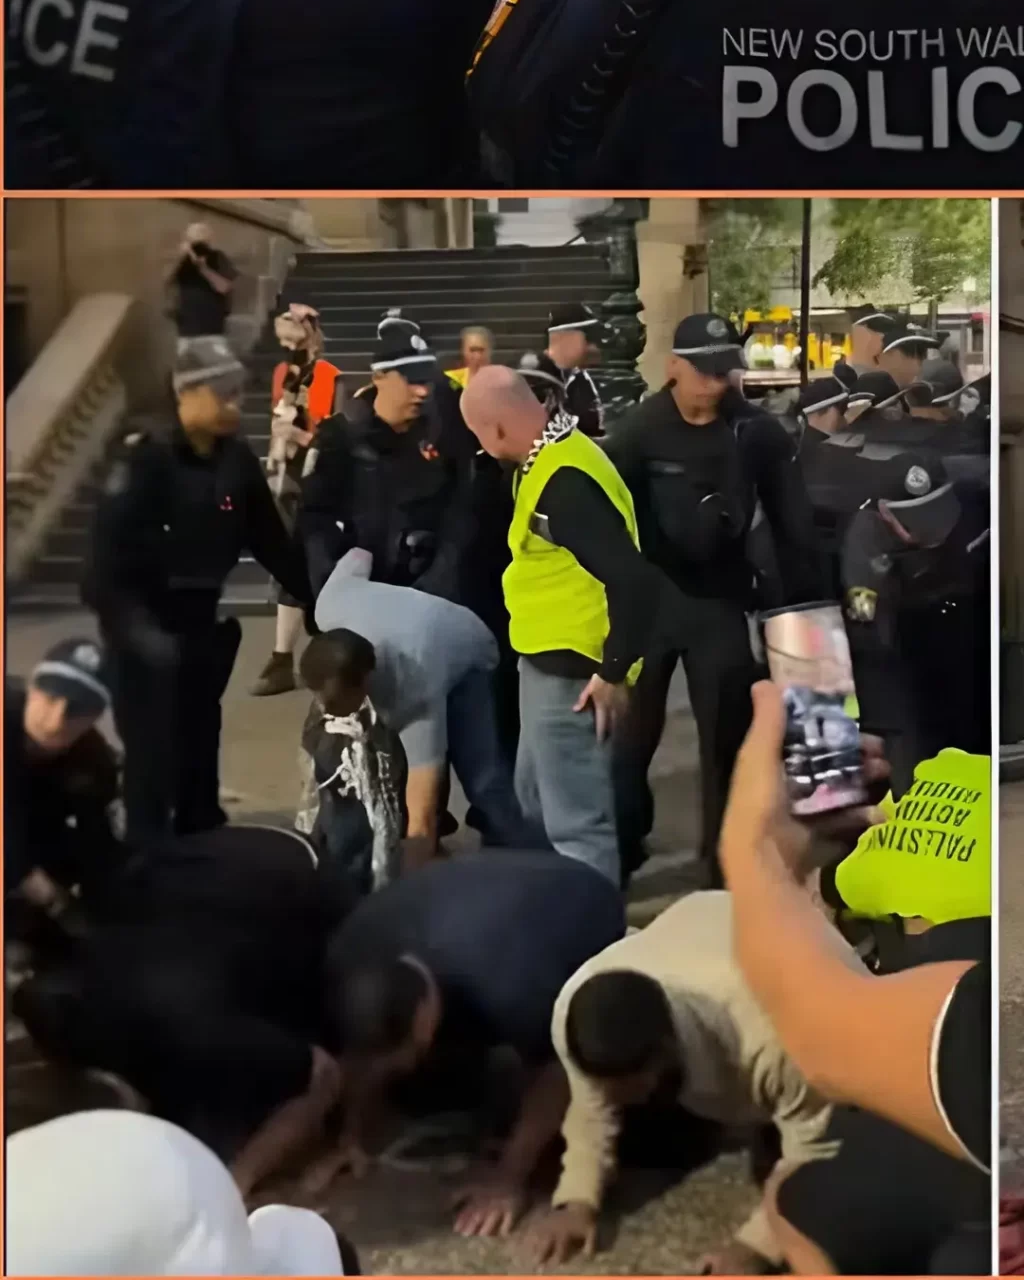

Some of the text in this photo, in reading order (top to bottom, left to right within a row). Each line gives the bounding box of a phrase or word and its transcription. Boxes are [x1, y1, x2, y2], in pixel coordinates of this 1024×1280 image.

[722, 27, 804, 60] NEW
[813, 27, 946, 61] SOUTH
[864, 824, 977, 862] PALSTIN
